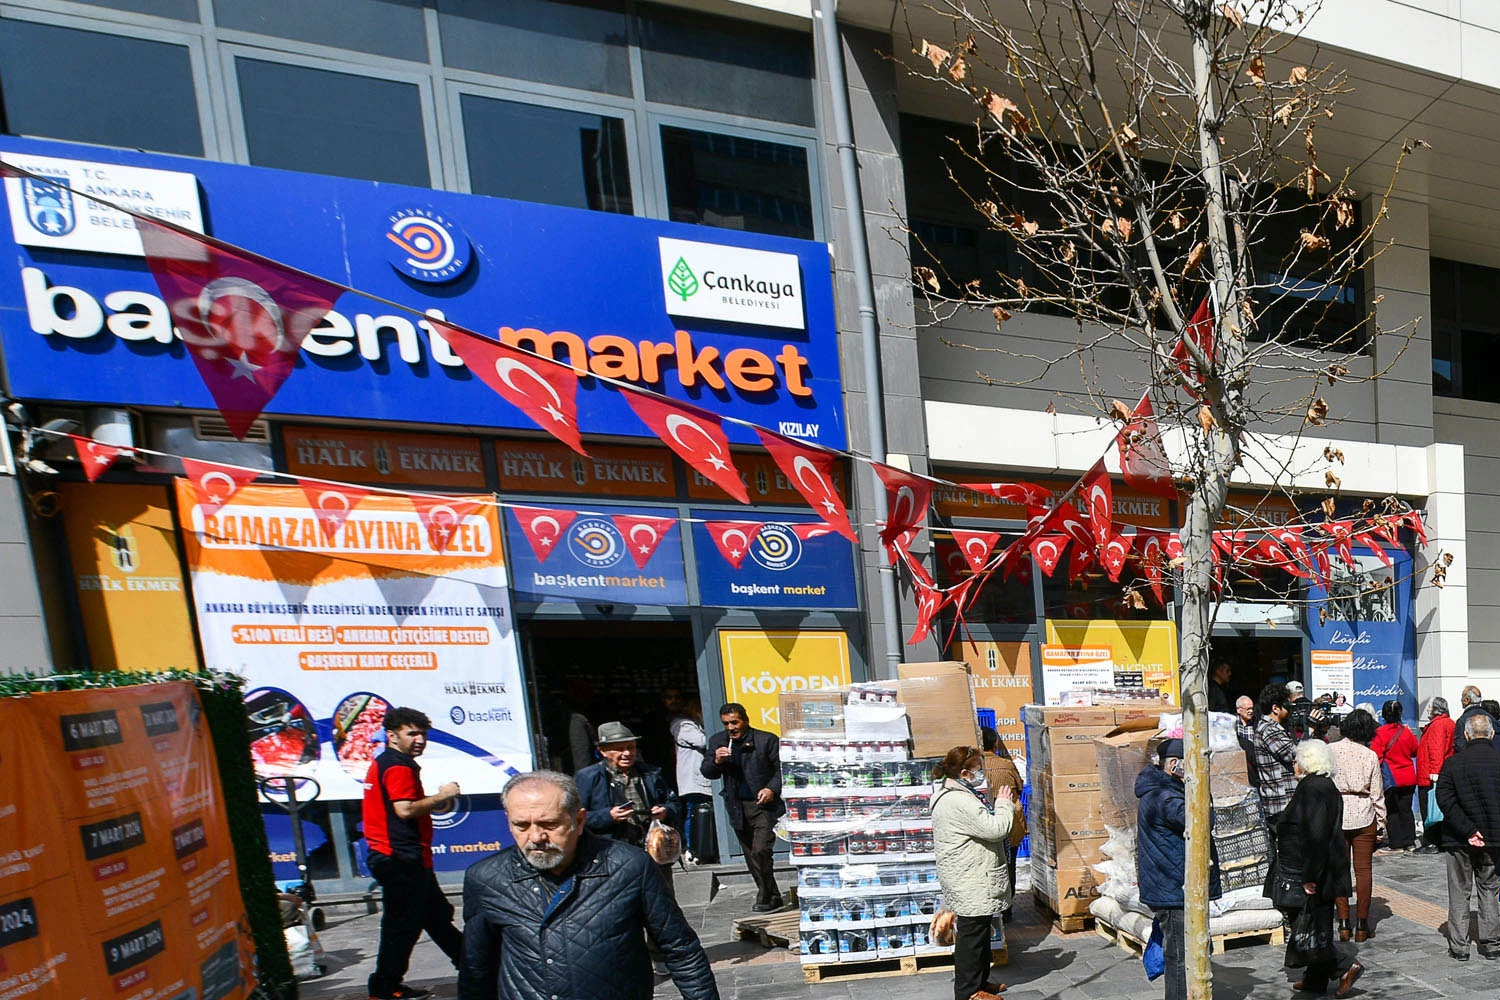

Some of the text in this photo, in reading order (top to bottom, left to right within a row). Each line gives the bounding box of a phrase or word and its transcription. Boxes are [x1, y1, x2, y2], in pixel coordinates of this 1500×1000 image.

[86, 185, 154, 201] ANKARA
[704, 271, 794, 299] Çankaya
[22, 267, 812, 397] başkent market
[779, 421, 819, 437] KIZILAY
[299, 447, 481, 473] HALK EKMEK
[503, 459, 667, 483] HALK EKMEK
[204, 514, 337, 548] RAMAZAN
[344, 520, 421, 551] AYINA
[80, 579, 181, 591] HALK EKMEK
[731, 583, 826, 596] başkent market
[206, 602, 244, 613] ANKARA
[248, 602, 310, 615] BÜYÜKŞEHİR
[396, 605, 427, 616] UYGUN
[430, 604, 462, 616] FİYATLI
[466, 607, 475, 617] ET
[477, 607, 504, 618] SATIŞI
[273, 627, 306, 642] YERLİ
[1329, 630, 1372, 651] Köylü
[360, 655, 388, 668] KART
[445, 685, 507, 694] HALK EKMEK
[740, 671, 840, 694] KÖYDEN
[991, 678, 1030, 688] EKMEK
[1353, 684, 1405, 697] ndisidir
[995, 717, 1016, 726] ADA
[90, 832, 98, 849] 7
[99, 825, 124, 846] MART
[450, 841, 501, 853] market
[0, 908, 34, 933] 2024
[110, 947, 119, 962] 9
[120, 936, 145, 960] MART
